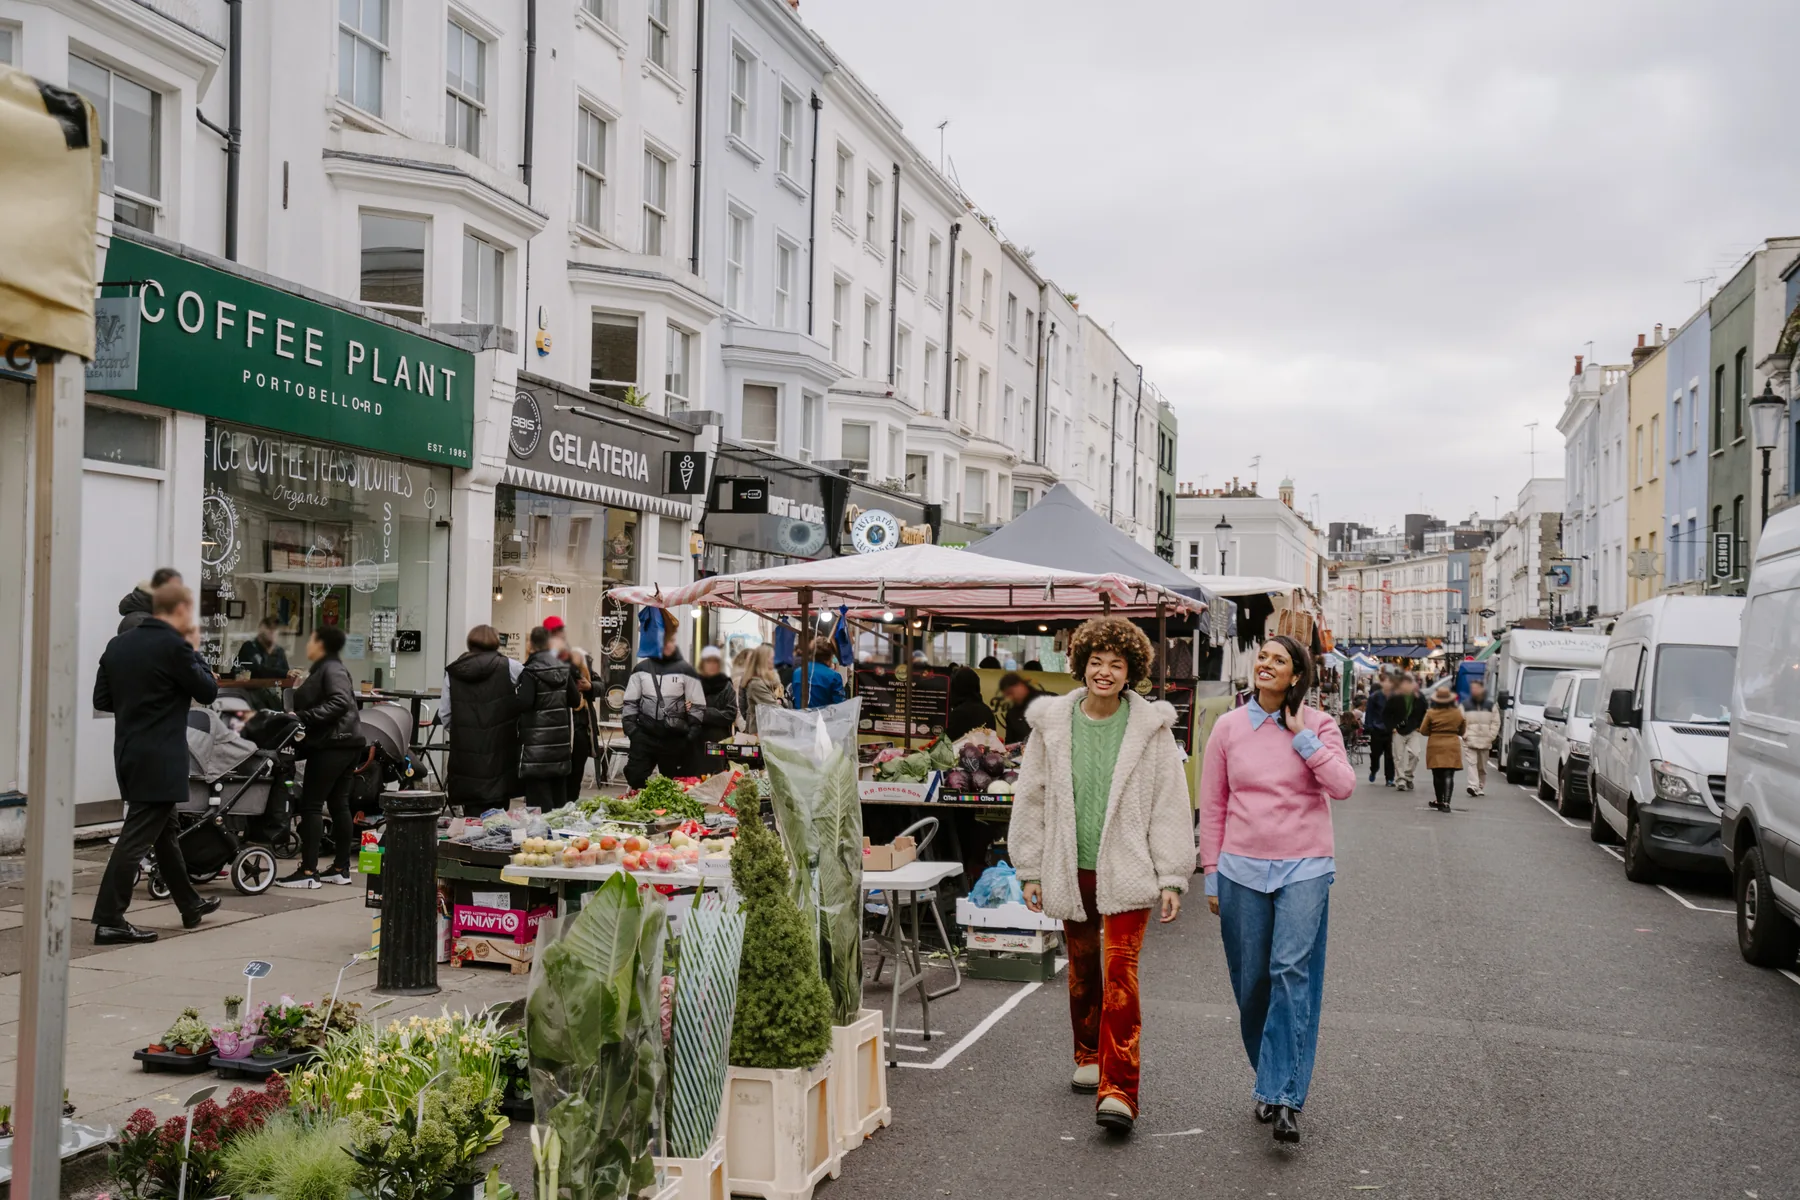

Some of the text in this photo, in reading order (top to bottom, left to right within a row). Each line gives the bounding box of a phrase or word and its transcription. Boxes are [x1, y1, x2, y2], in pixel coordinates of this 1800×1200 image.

[139, 279, 457, 402] COFFEE PLANT
[85, 370, 104, 378] LSEA
[88, 352, 130, 369] ttard
[213, 426, 240, 471] ICE
[245, 435, 307, 481] COFFEE
[427, 442, 467, 458] EST. 1985
[548, 430, 649, 484] GELATERIA
[273, 484, 329, 511] Organic
[789, 499, 801, 519] in
[801, 503, 825, 525] CASE
[383, 501, 392, 562] SOUP
[216, 549, 241, 578] Beans
[1717, 536, 1728, 573] HONEST
[459, 914, 503, 929] LAVINIA
